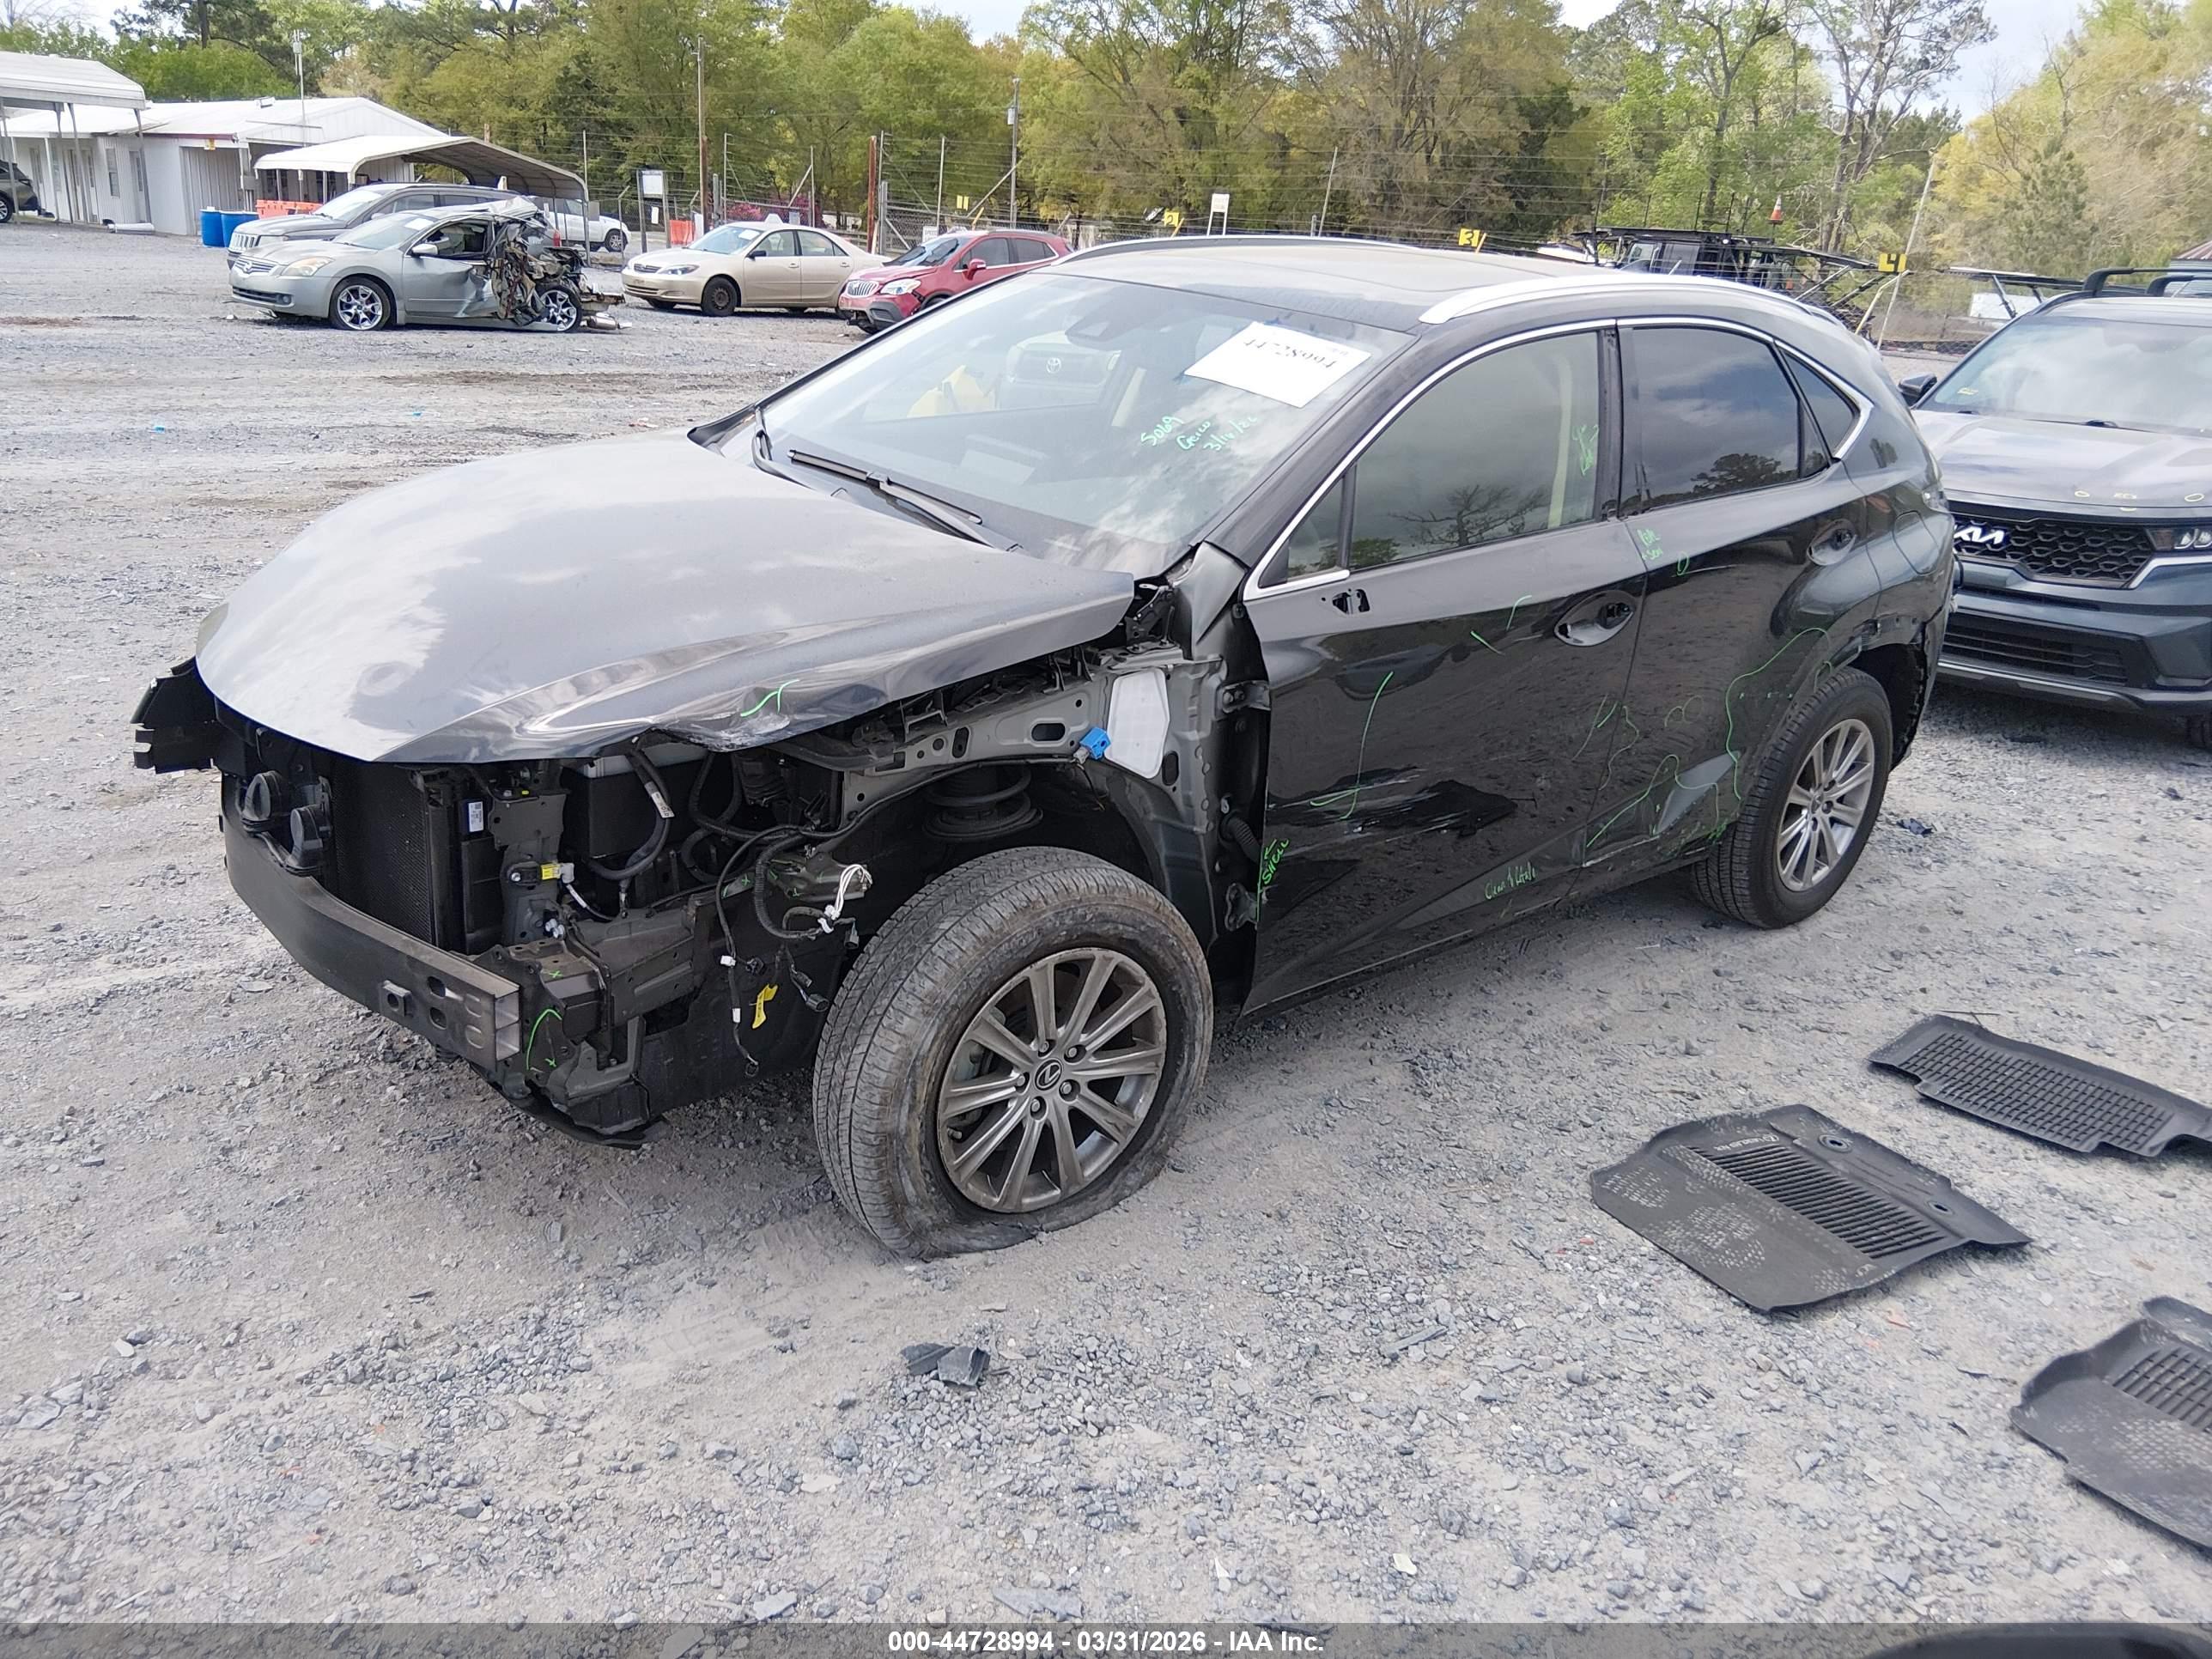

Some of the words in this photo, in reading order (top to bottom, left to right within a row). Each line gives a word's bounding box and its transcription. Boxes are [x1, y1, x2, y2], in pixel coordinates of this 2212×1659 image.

[1167, 214, 1176, 227] 2
[1463, 229, 1474, 246] 3
[1887, 253, 1900, 272] 4
